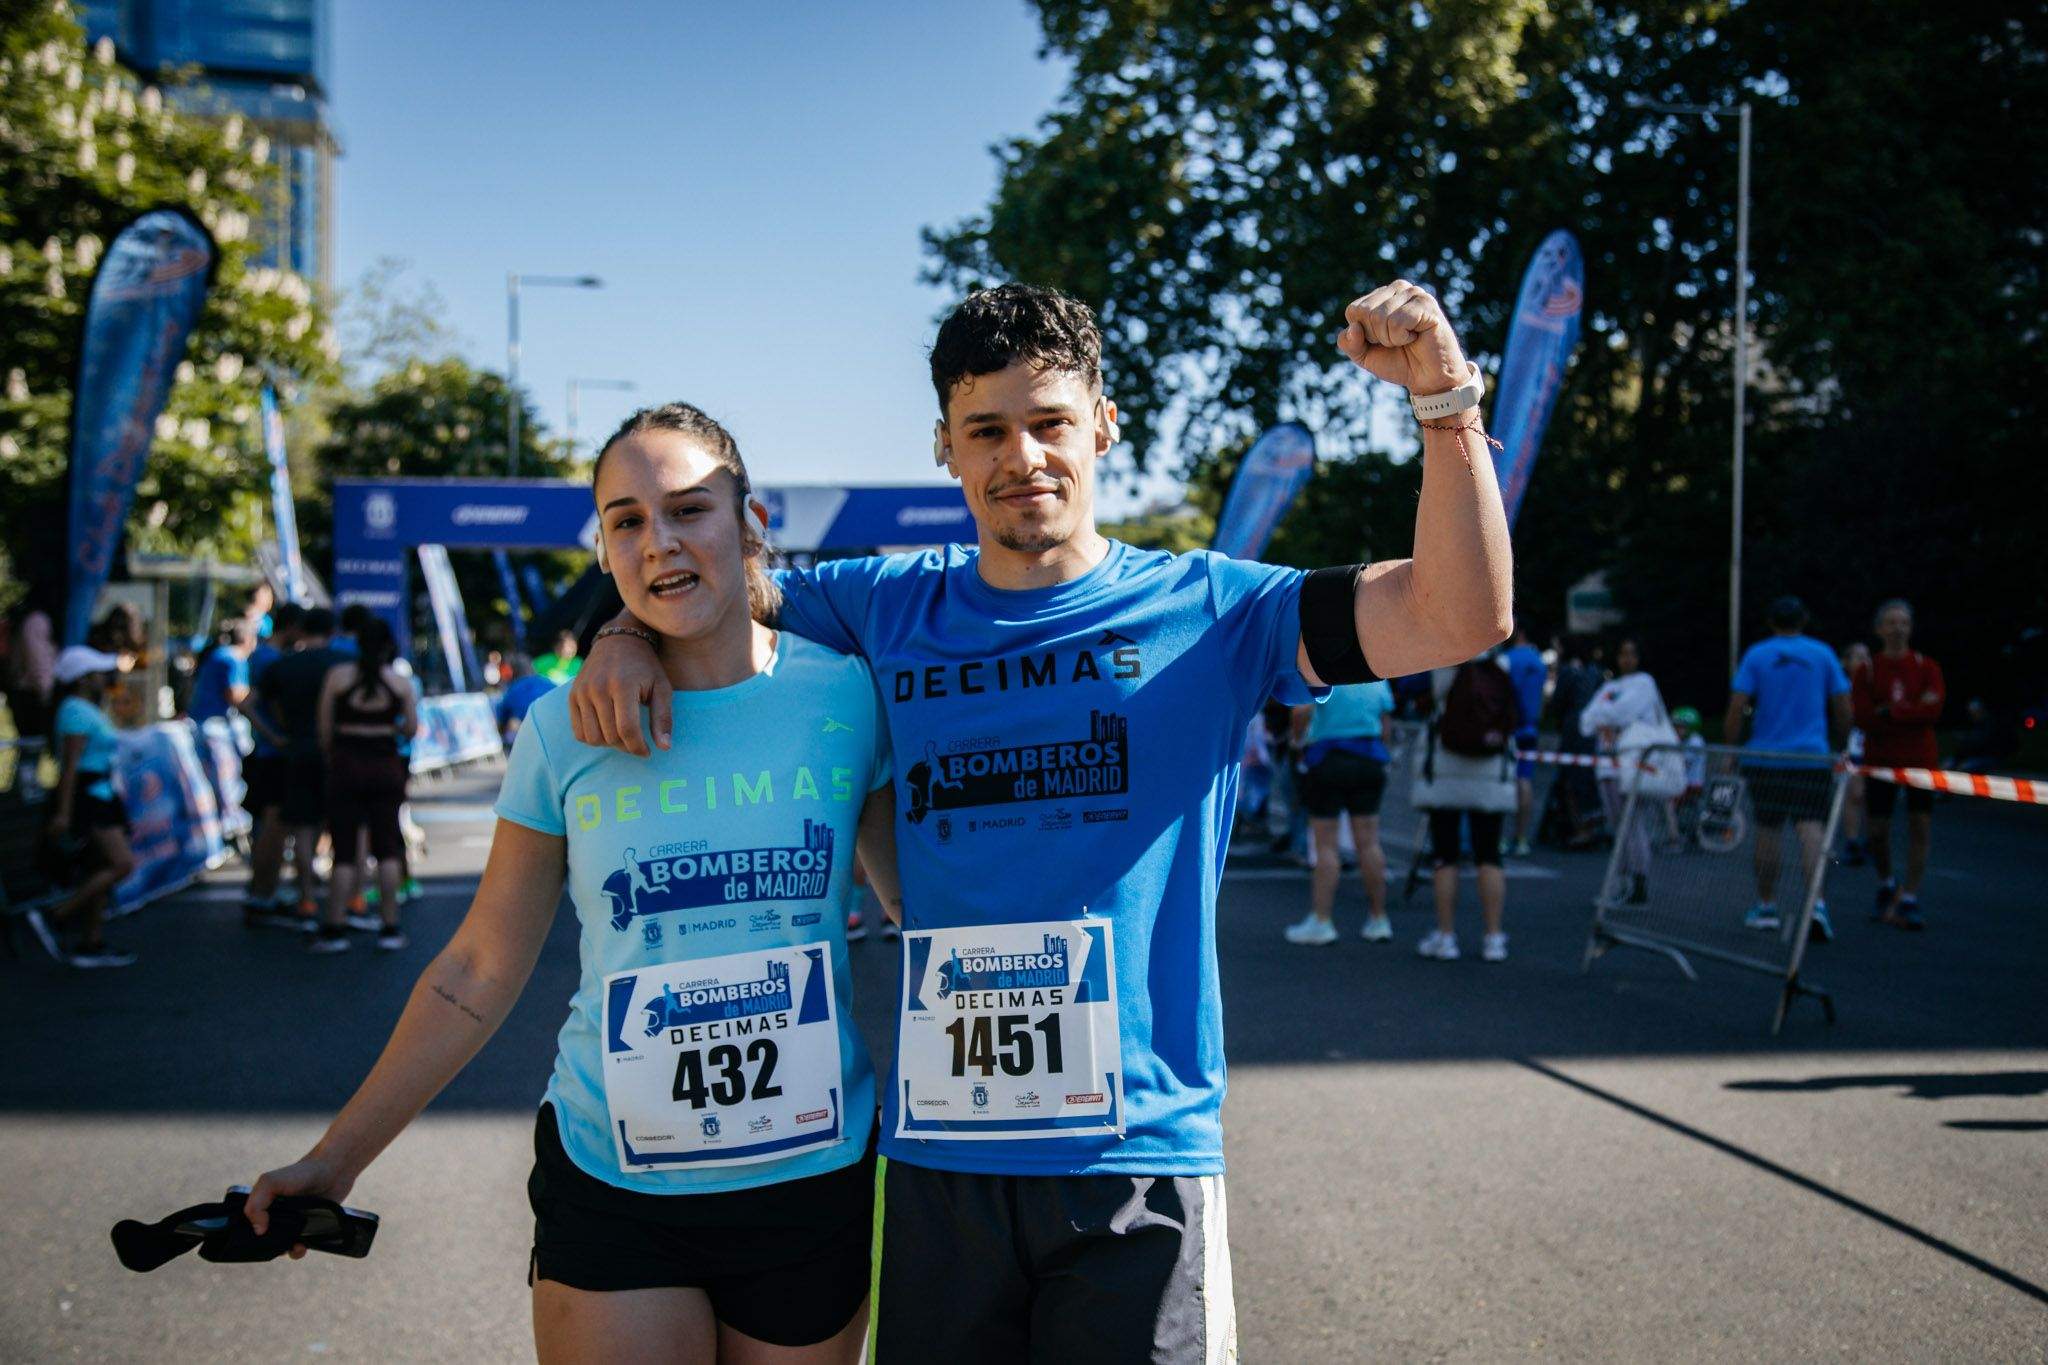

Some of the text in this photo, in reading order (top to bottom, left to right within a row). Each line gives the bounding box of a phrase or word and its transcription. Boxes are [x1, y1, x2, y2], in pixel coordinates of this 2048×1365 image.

[894, 648, 1142, 703] DECIMAS
[947, 736, 1001, 752] CARRERA
[949, 741, 1120, 779] BOMBEROS
[1014, 766, 1122, 798] de MADRID
[575, 766, 854, 832] DECIMAS
[982, 817, 1026, 829] MADRID
[648, 840, 708, 858] CARRERA
[650, 849, 828, 883] BOMBEROS
[724, 872, 826, 901] de MADRID
[692, 919, 736, 933] MADRID
[962, 947, 996, 956] CARRERA
[962, 953, 1064, 973] BOMBEROS
[678, 977, 720, 989] CARRERA
[998, 968, 1065, 988] de MADRID
[679, 978, 787, 1008] BOMBEROS
[724, 993, 788, 1017] de MADRID
[956, 989, 1063, 1010] DECIMAS
[671, 1012, 788, 1045] DECIMAS
[945, 1012, 1064, 1077] 1451
[672, 1038, 783, 1110] 432
